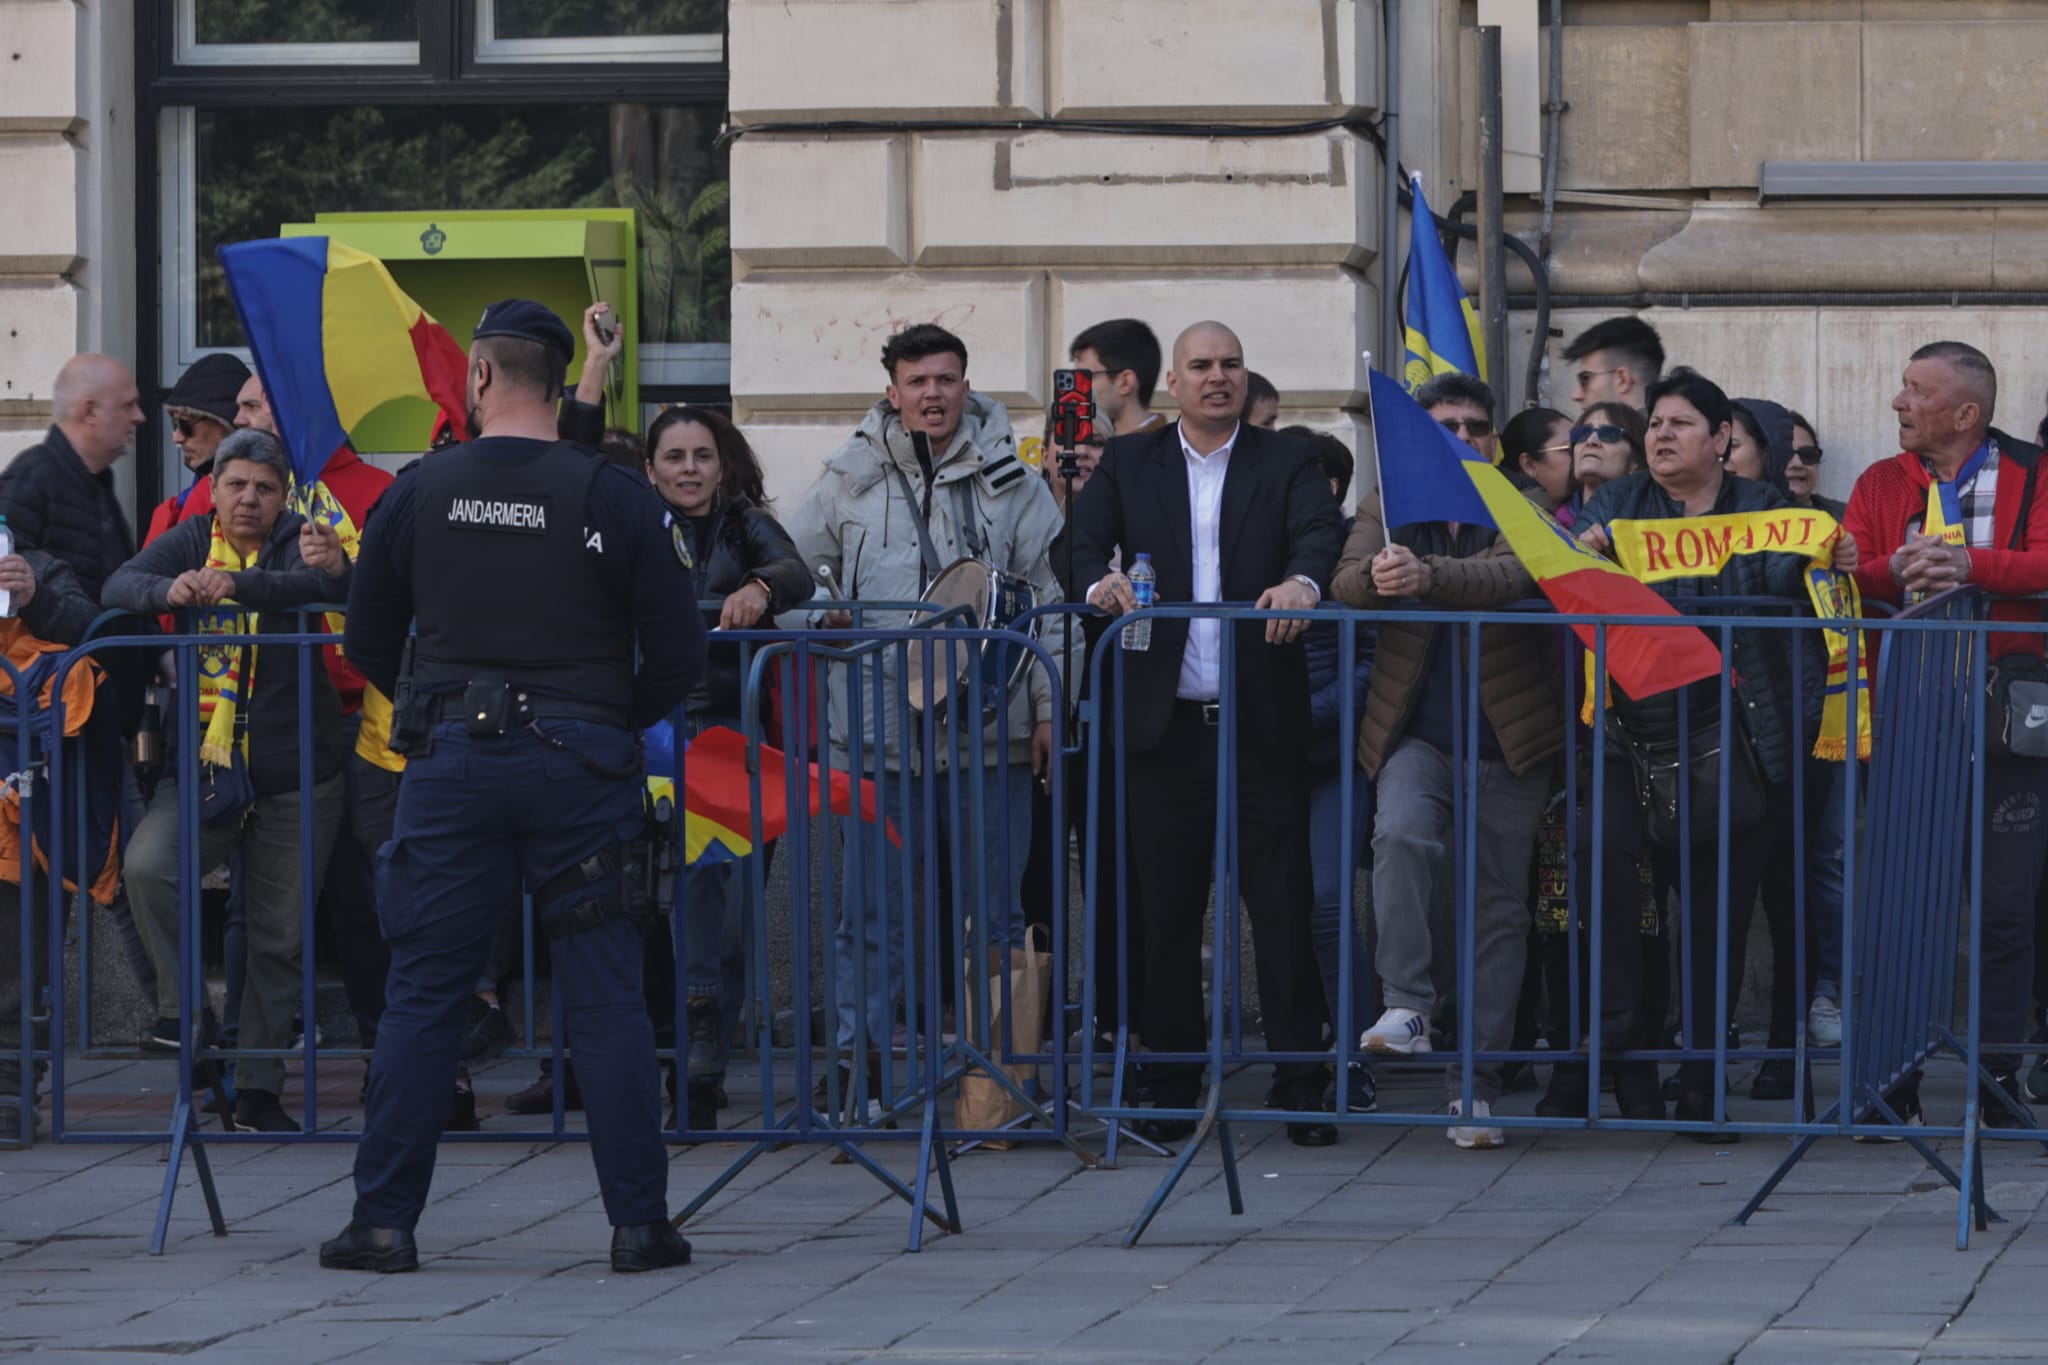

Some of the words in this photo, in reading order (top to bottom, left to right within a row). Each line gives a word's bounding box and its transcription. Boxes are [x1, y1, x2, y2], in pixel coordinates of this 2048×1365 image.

[448, 498, 546, 529] JANDARMERIA
[1943, 529, 1963, 541] NIA
[199, 687, 221, 697] OMA
